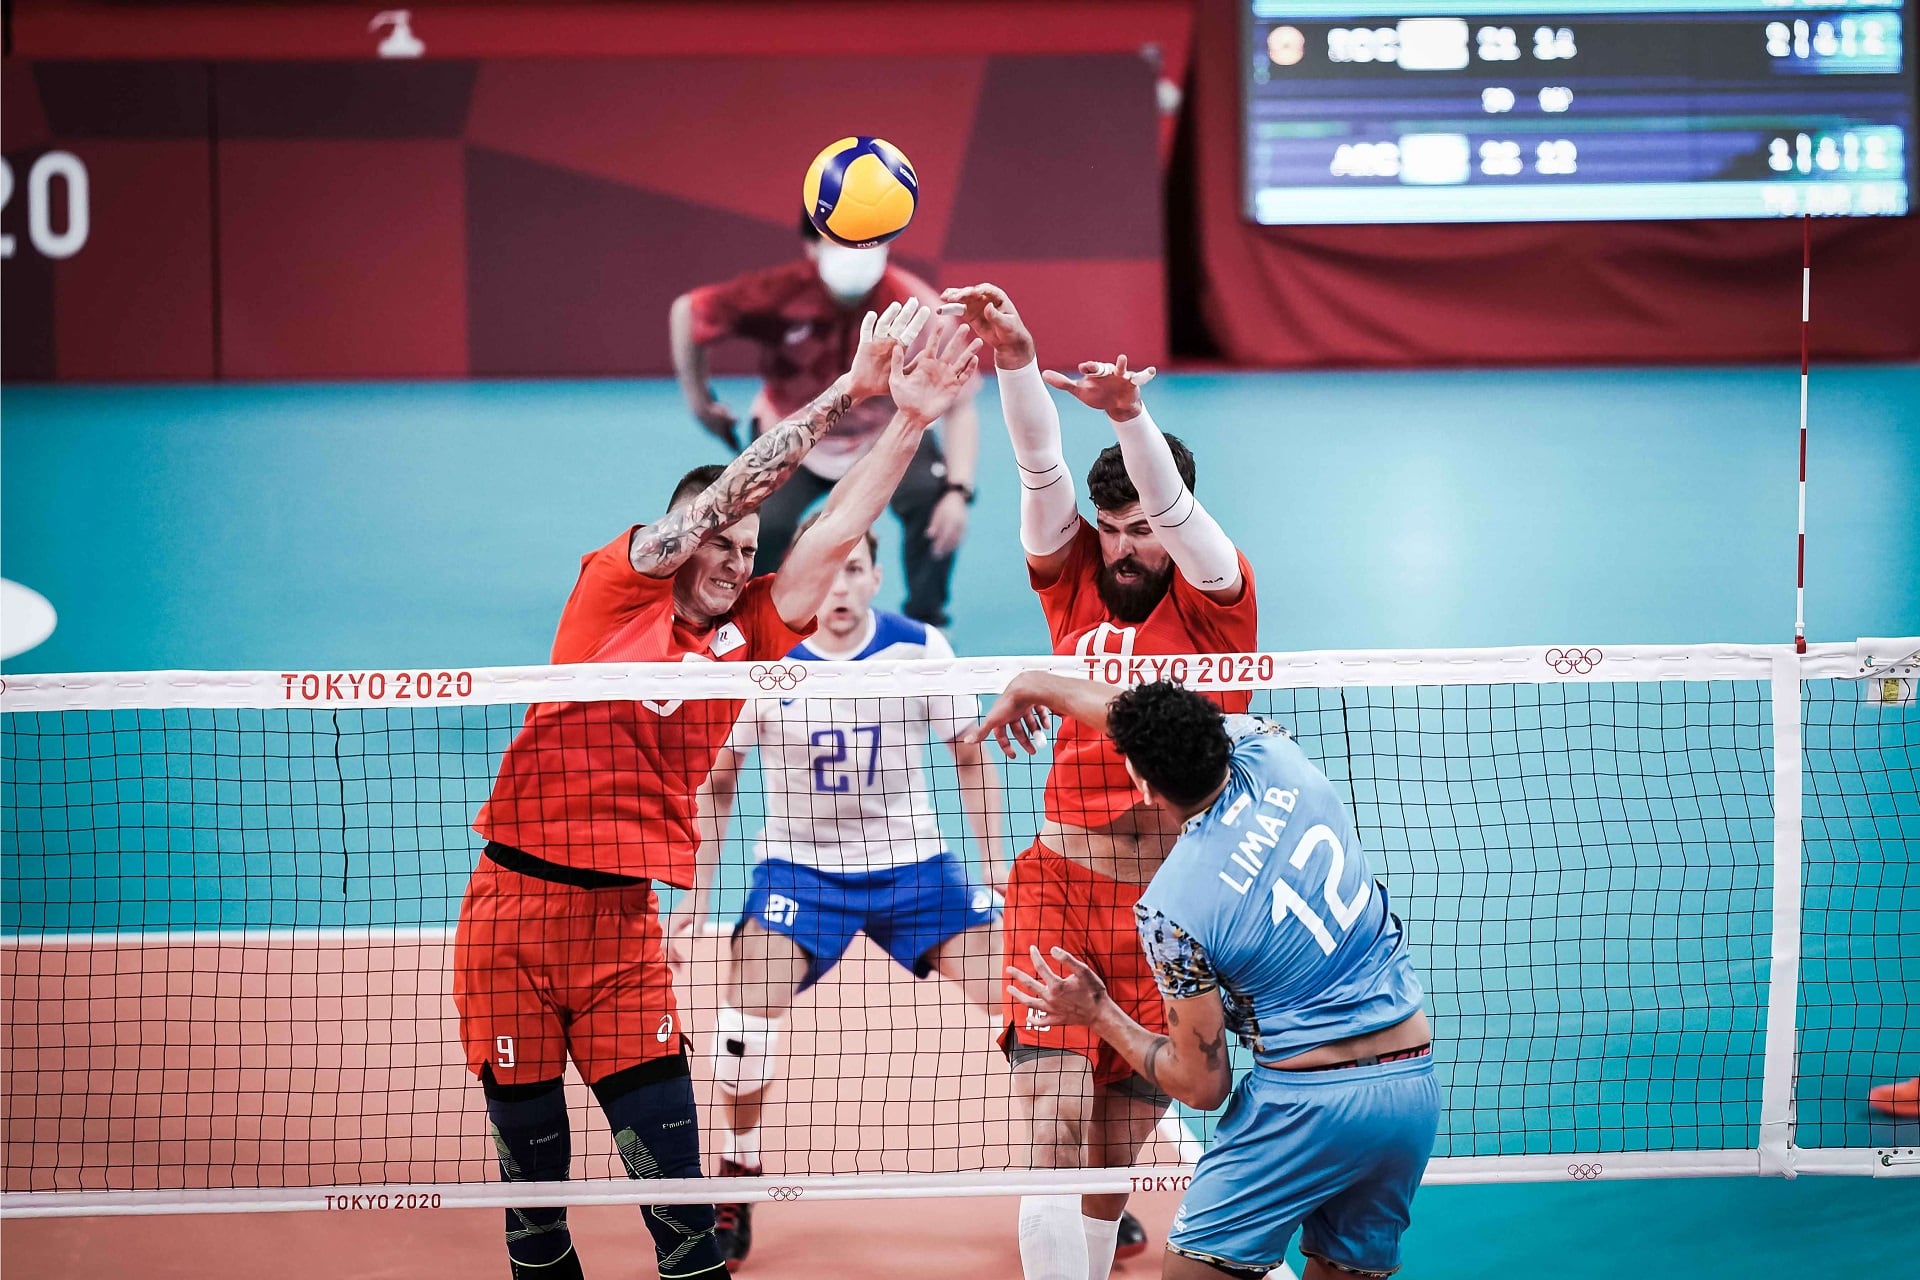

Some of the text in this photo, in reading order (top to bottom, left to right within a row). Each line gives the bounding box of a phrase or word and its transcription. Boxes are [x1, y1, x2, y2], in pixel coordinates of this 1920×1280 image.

[0, 150, 90, 259] 0
[281, 671, 472, 700] TOKYO 2020
[1084, 655, 1274, 684] TOKYO 2020
[811, 725, 880, 793] 27
[1218, 786, 1299, 896] LIMA B.
[1271, 824, 1371, 957] 12
[496, 1036, 515, 1068] 9
[1129, 1175, 1192, 1192] TOKYO
[325, 1193, 441, 1210] TOKYO 2020
